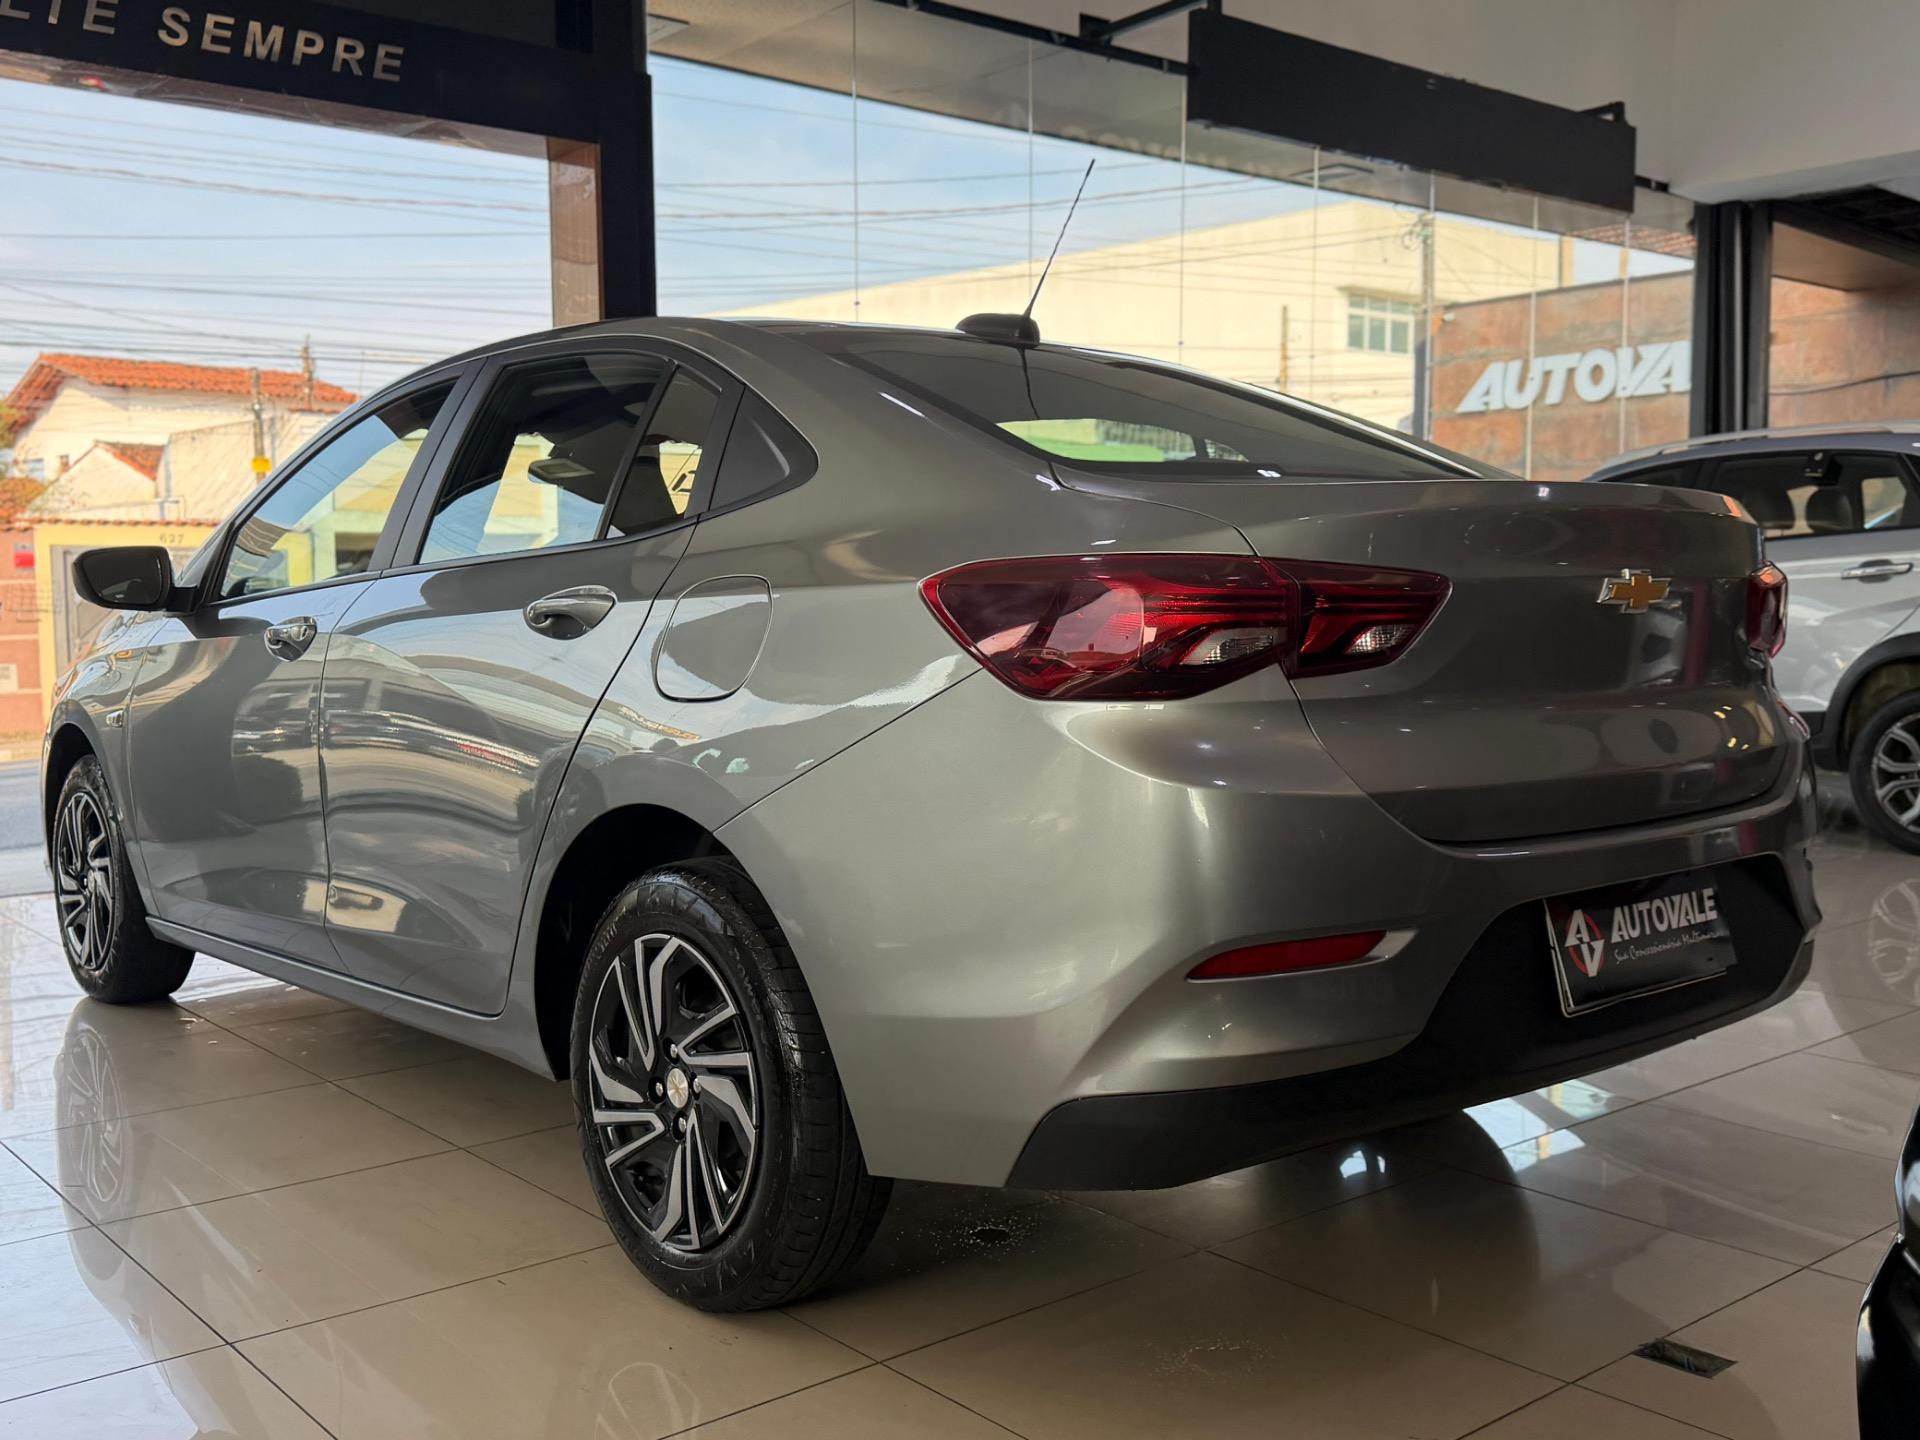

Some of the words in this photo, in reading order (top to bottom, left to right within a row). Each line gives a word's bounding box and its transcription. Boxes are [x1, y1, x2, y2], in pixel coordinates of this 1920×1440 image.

[157, 6, 405, 83] SEMPRE
[1455, 340, 1692, 414] AUTOVA
[1610, 887, 1719, 944] AUTOVALE
